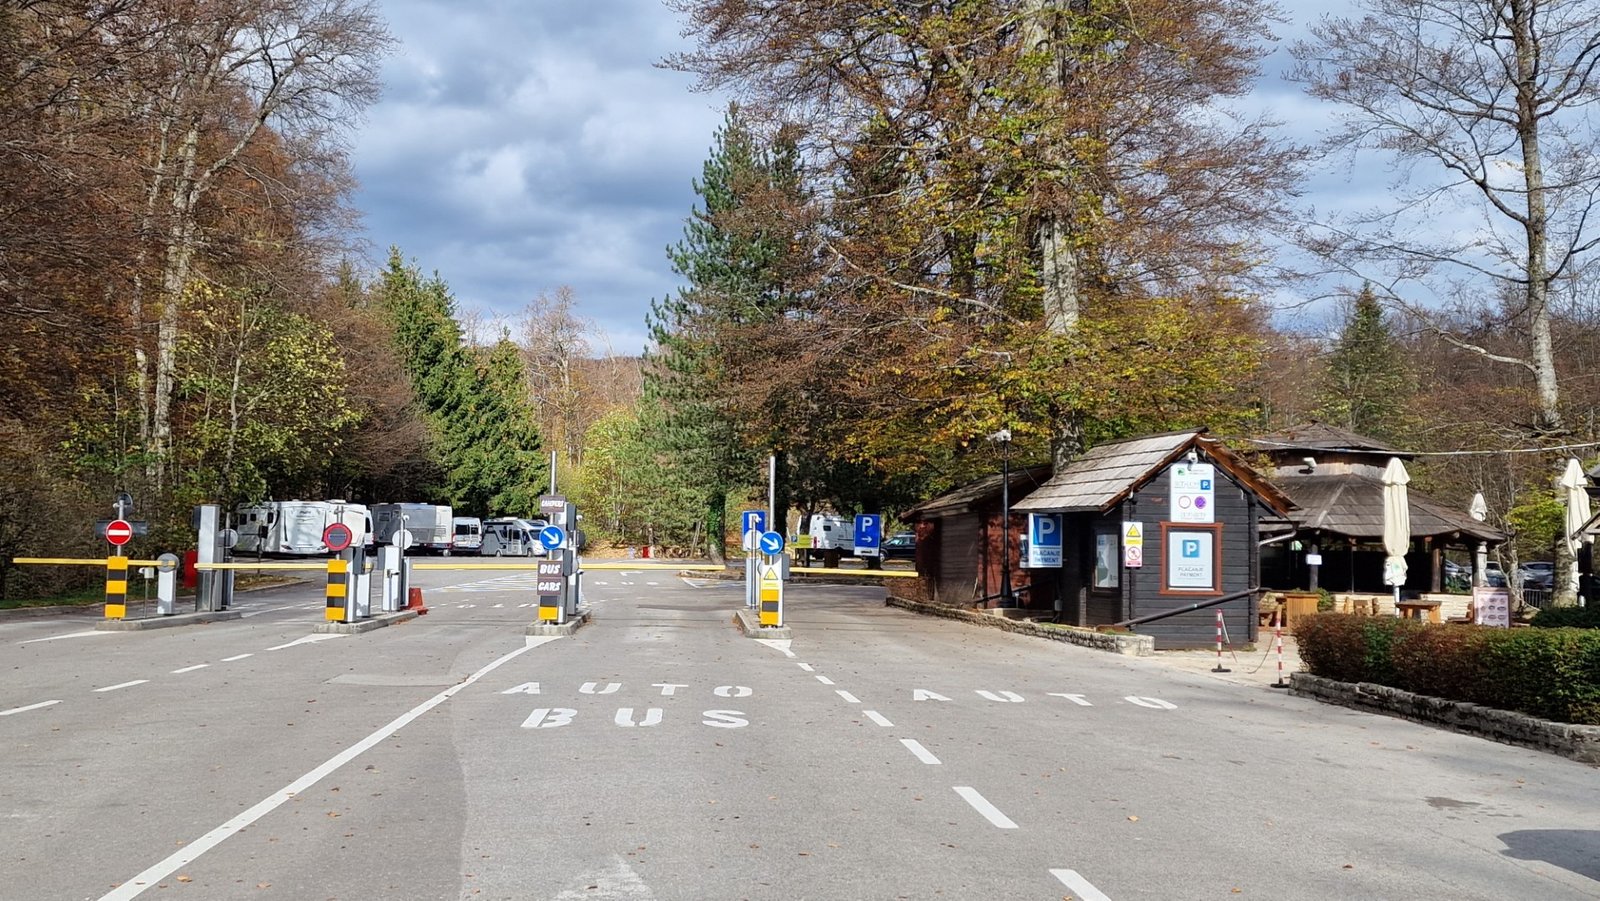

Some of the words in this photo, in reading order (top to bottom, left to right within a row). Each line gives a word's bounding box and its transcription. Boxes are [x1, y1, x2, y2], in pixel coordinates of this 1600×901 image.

[862, 516, 873, 532] P
[1038, 517, 1055, 543] P
[1186, 542, 1197, 556] P
[540, 564, 560, 575] BUS
[538, 581, 561, 591] CARS
[501, 681, 753, 698] AUTO
[913, 688, 1178, 710] AUTO
[520, 707, 750, 729] BUS
